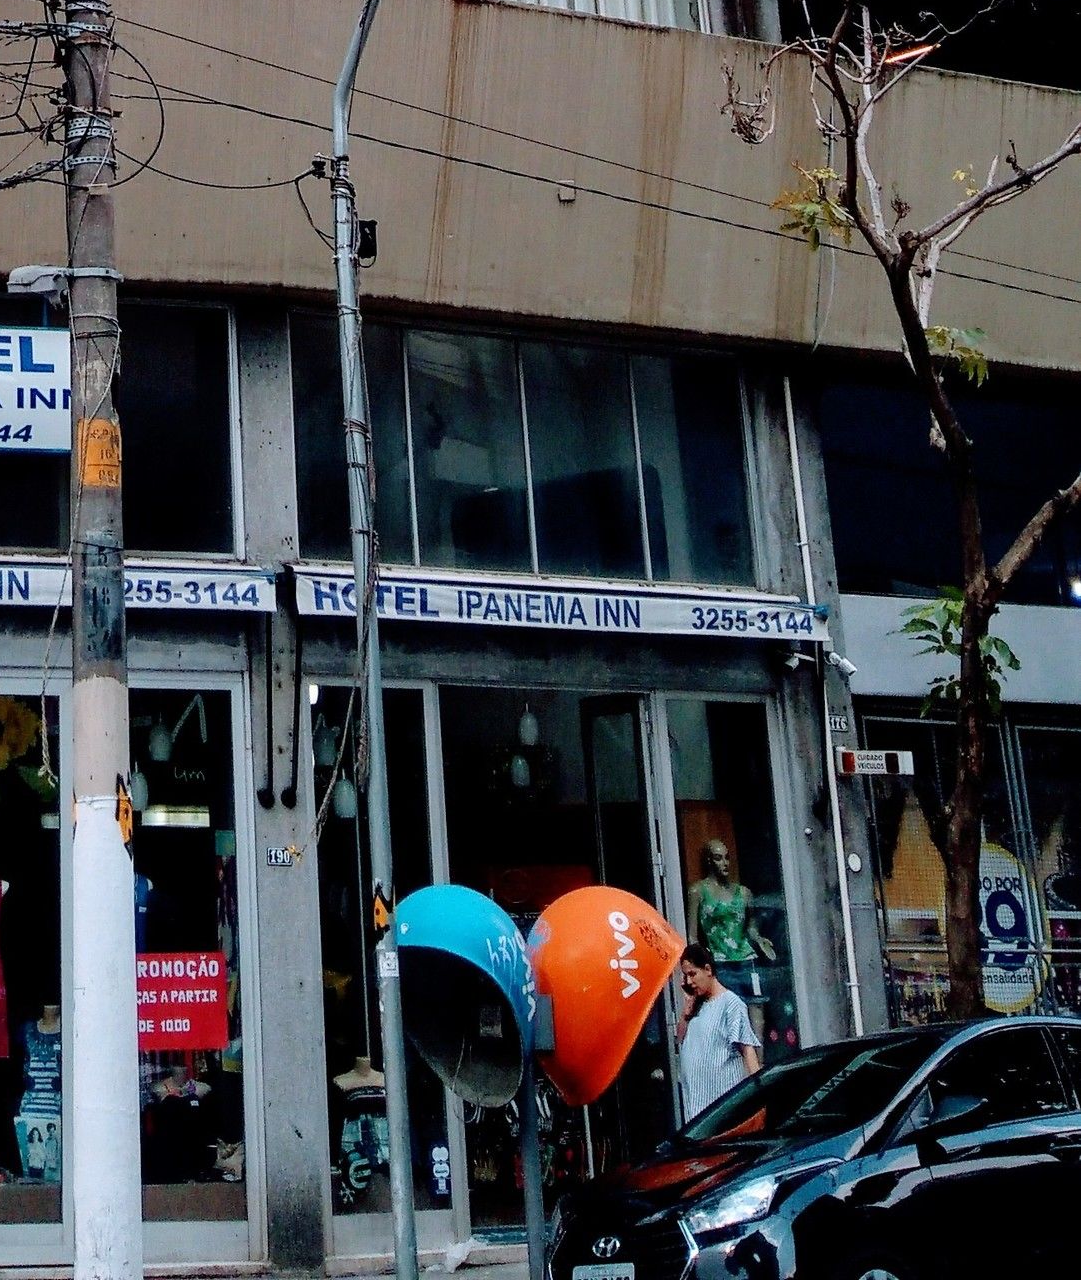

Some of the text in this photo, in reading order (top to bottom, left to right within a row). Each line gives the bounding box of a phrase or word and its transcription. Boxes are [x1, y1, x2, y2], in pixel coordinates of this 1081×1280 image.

[123, 578, 260, 607] 255-3144
[457, 589, 588, 627] IPANEMA
[595, 598, 642, 629] INN
[691, 606, 813, 634] 3255-3144
[270, 850, 290, 863] 190
[137, 954, 219, 980] ROMOÇÃO
[608, 910, 641, 1000] vivo
[160, 990, 169, 1003] A
[170, 989, 218, 1003] PARTIR
[138, 1020, 155, 1033] DE
